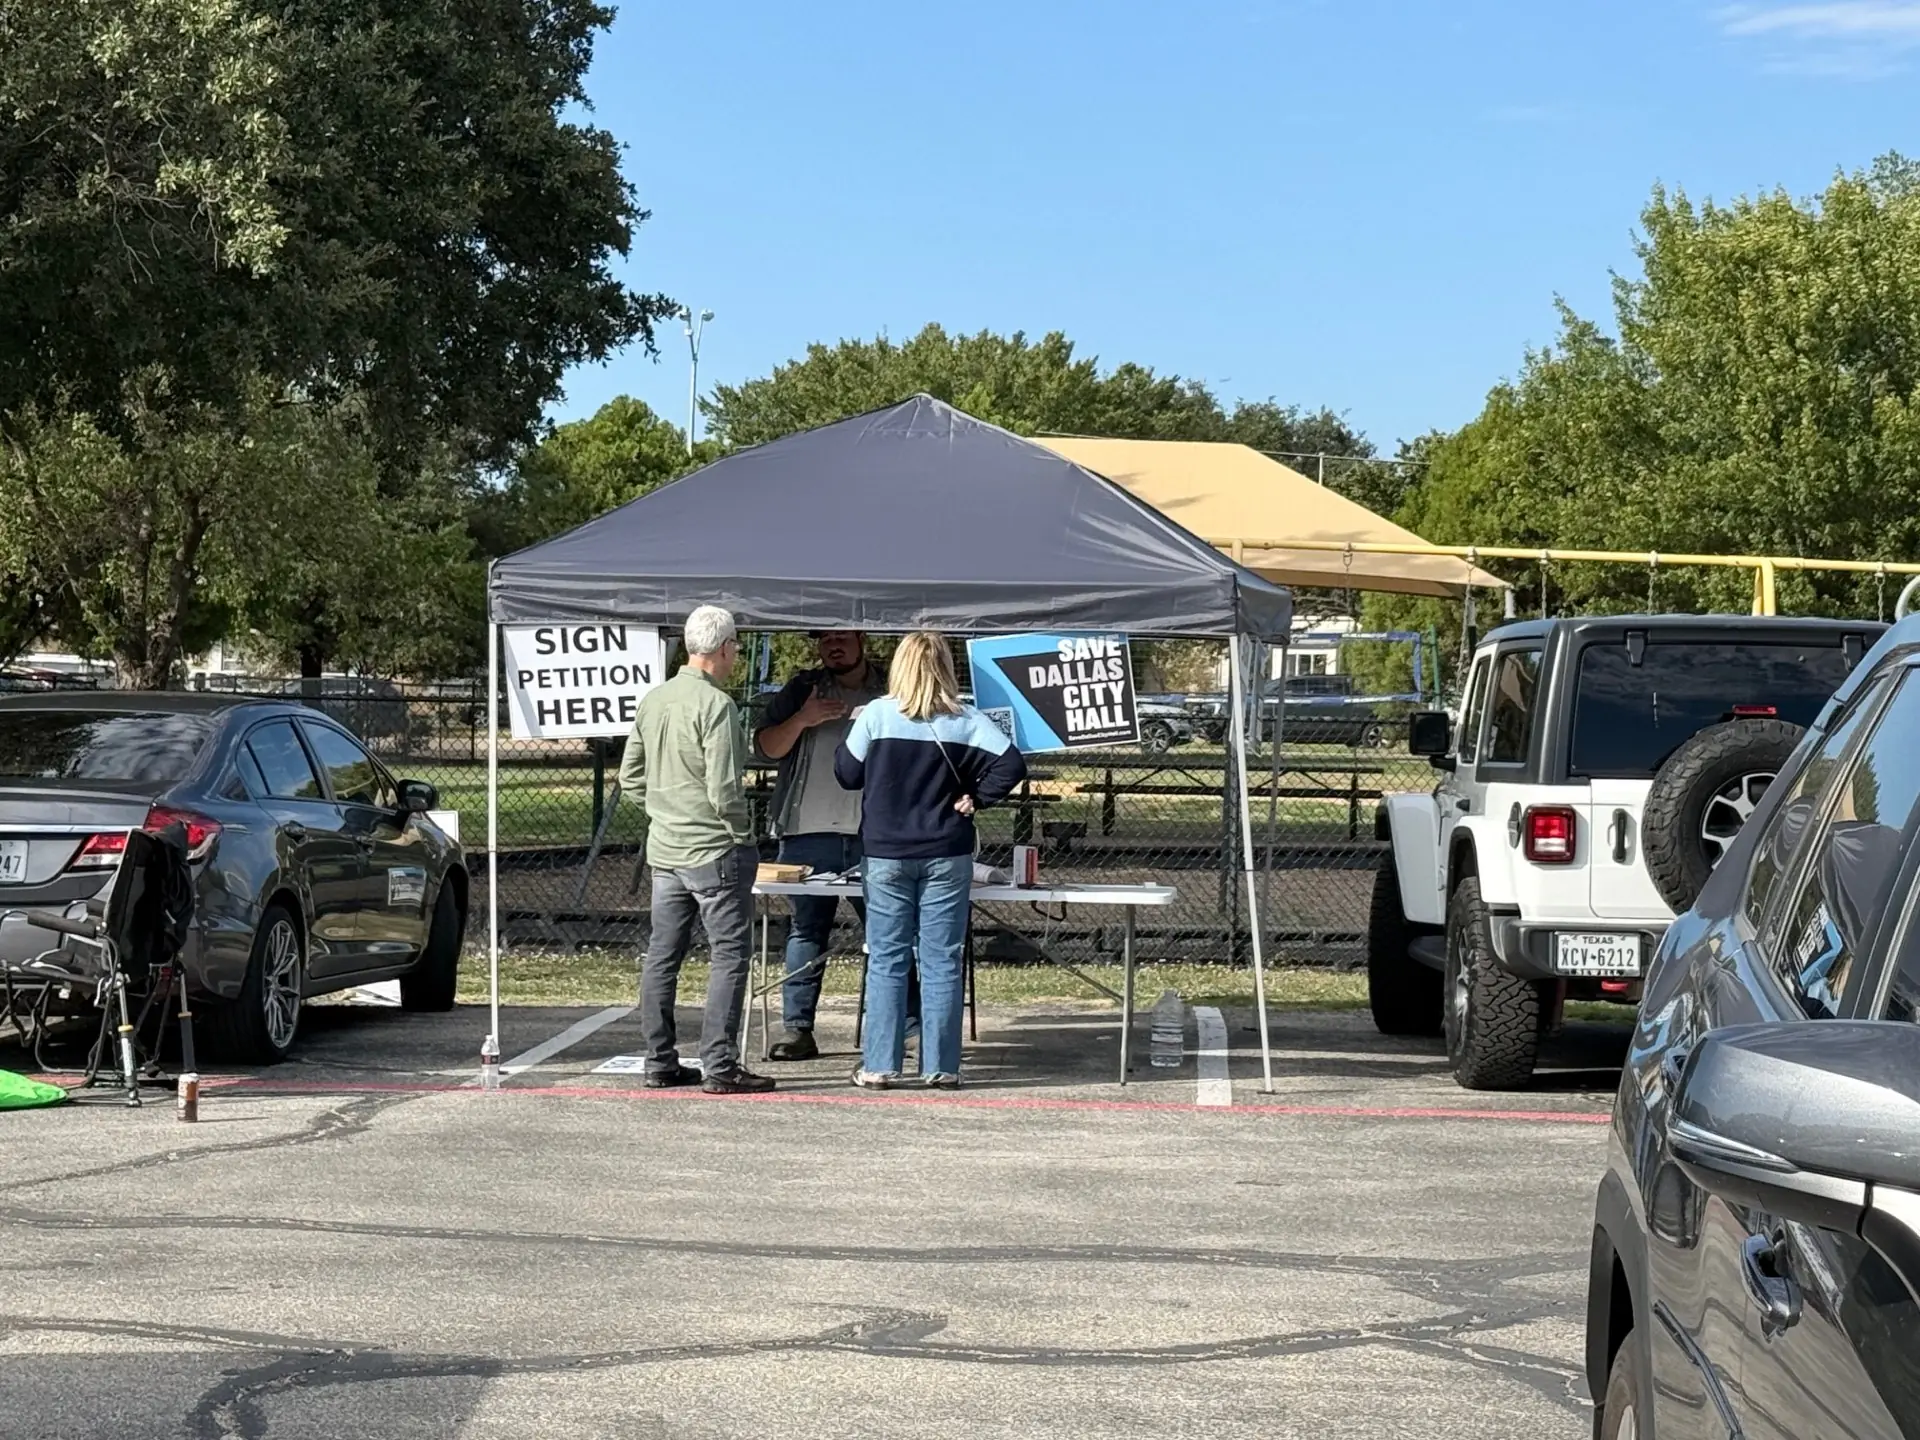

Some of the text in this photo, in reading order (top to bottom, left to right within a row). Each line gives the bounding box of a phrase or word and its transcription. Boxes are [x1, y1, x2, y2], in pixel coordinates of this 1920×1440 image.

[534, 625, 628, 655] SIGN
[1057, 634, 1122, 662] SAVE
[518, 664, 651, 690] PETITION
[1028, 657, 1124, 689] DALLAS
[1062, 680, 1125, 709] CITY
[536, 695, 637, 727] HERE
[1065, 704, 1131, 732] HALL
[1582, 936, 1614, 945] TEXAS
